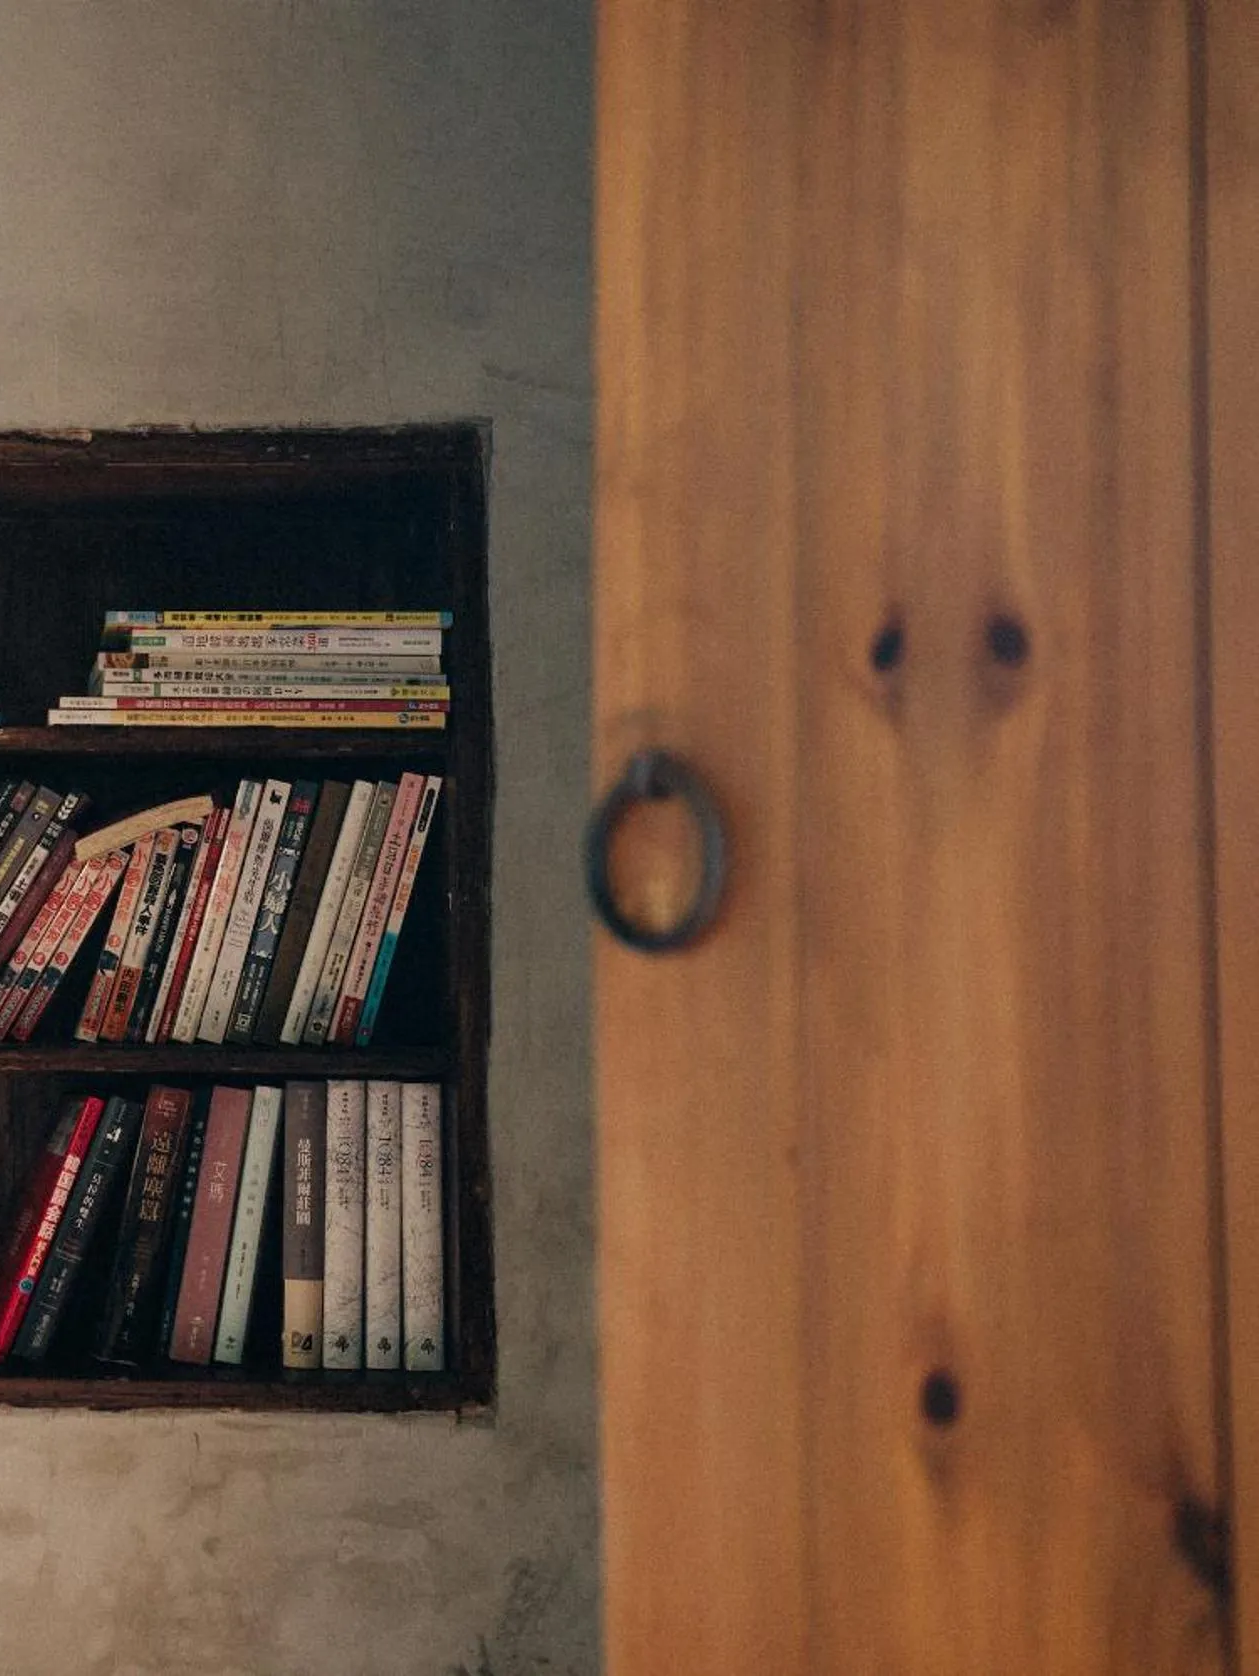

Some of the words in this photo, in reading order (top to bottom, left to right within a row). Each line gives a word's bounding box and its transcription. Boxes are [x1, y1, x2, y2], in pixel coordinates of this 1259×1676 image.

[295, 1137, 314, 1226] 曼斯菲爾莊園
